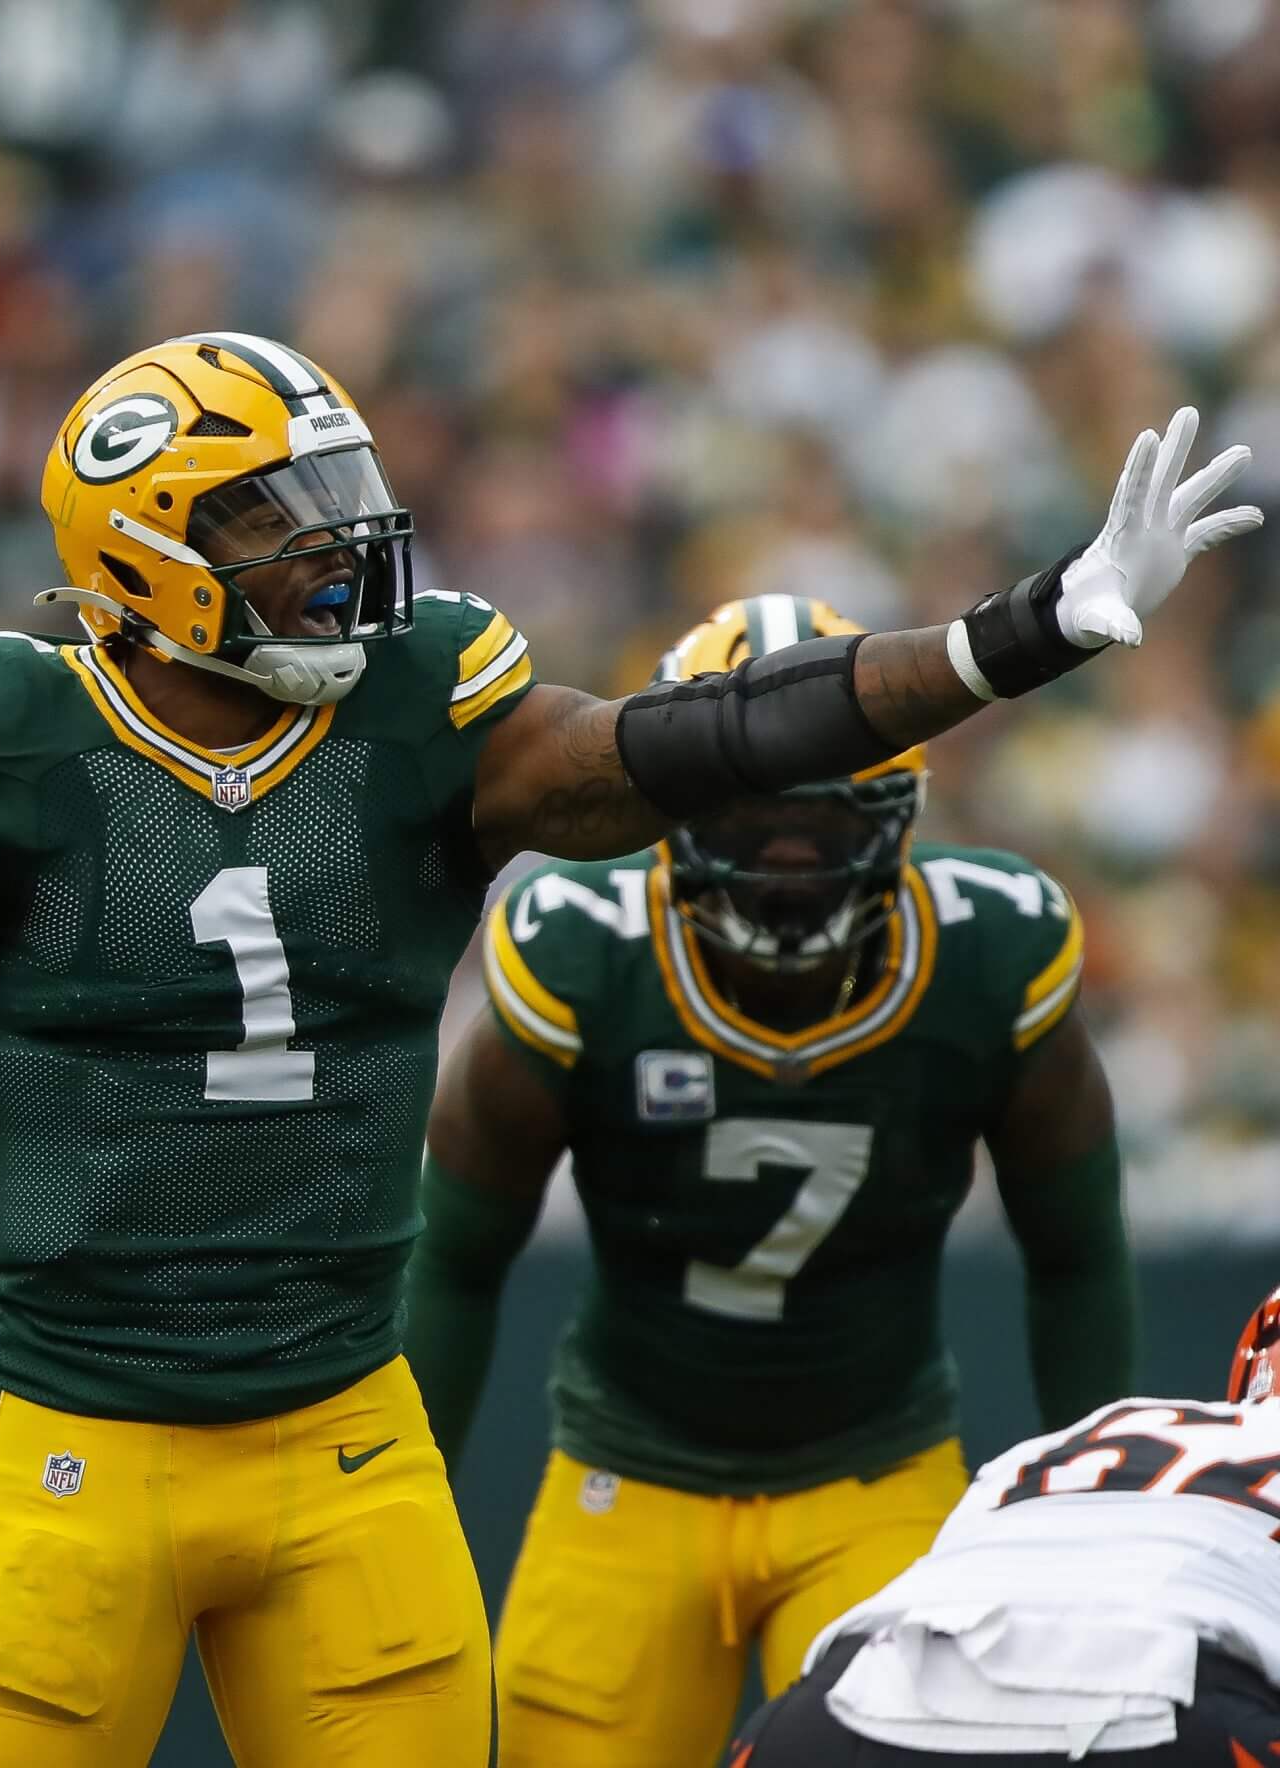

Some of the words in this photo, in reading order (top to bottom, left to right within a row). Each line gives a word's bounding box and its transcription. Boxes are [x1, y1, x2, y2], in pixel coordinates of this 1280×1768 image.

[74, 398, 171, 478] G
[310, 412, 351, 432] PACKERS
[219, 785, 245, 803] NFL
[535, 869, 650, 938] 7
[920, 857, 1043, 925] 7
[189, 866, 315, 1101] 1
[645, 1056, 709, 1101] C
[684, 1116, 875, 1322] 7
[49, 1470, 75, 1489] NFL
